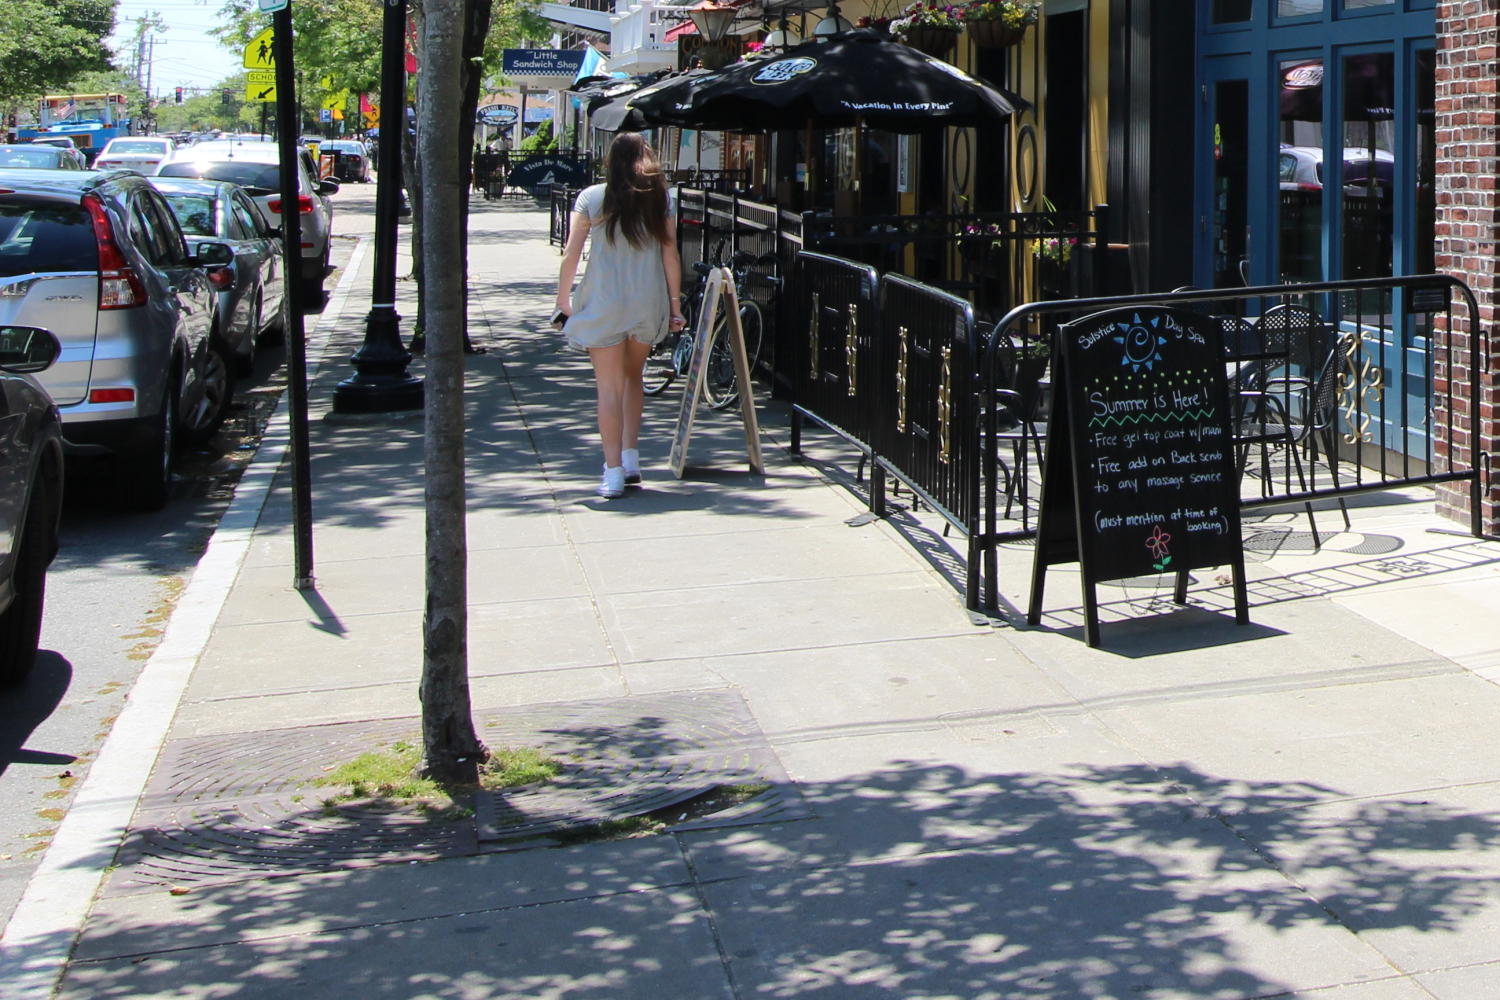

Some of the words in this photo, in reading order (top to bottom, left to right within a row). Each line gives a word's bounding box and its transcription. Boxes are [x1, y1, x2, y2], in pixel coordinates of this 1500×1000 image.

[512, 59, 554, 69] Sandwich
[556, 60, 579, 70] Shop
[533, 51, 558, 60] Little
[1078, 322, 1115, 350] Solstice
[1165, 314, 1183, 339] Day
[1188, 326, 1206, 345] Spa
[1090, 391, 1149, 417] Summer
[1153, 392, 1167, 409] is
[1095, 432, 1118, 448] Free
[1123, 431, 1140, 448] gel
[1144, 429, 1161, 444] top
[1164, 429, 1185, 440] coat
[1098, 456, 1121, 475] Free
[1128, 456, 1148, 470] add
[1152, 456, 1166, 466] on
[1171, 450, 1197, 464] Back
[1094, 480, 1109, 493] to
[1118, 478, 1138, 493] any
[1147, 475, 1185, 490] massage
[1126, 512, 1165, 525] mention
[1170, 508, 1181, 520] at
[1184, 508, 1206, 519] time
[1209, 507, 1218, 516] of
